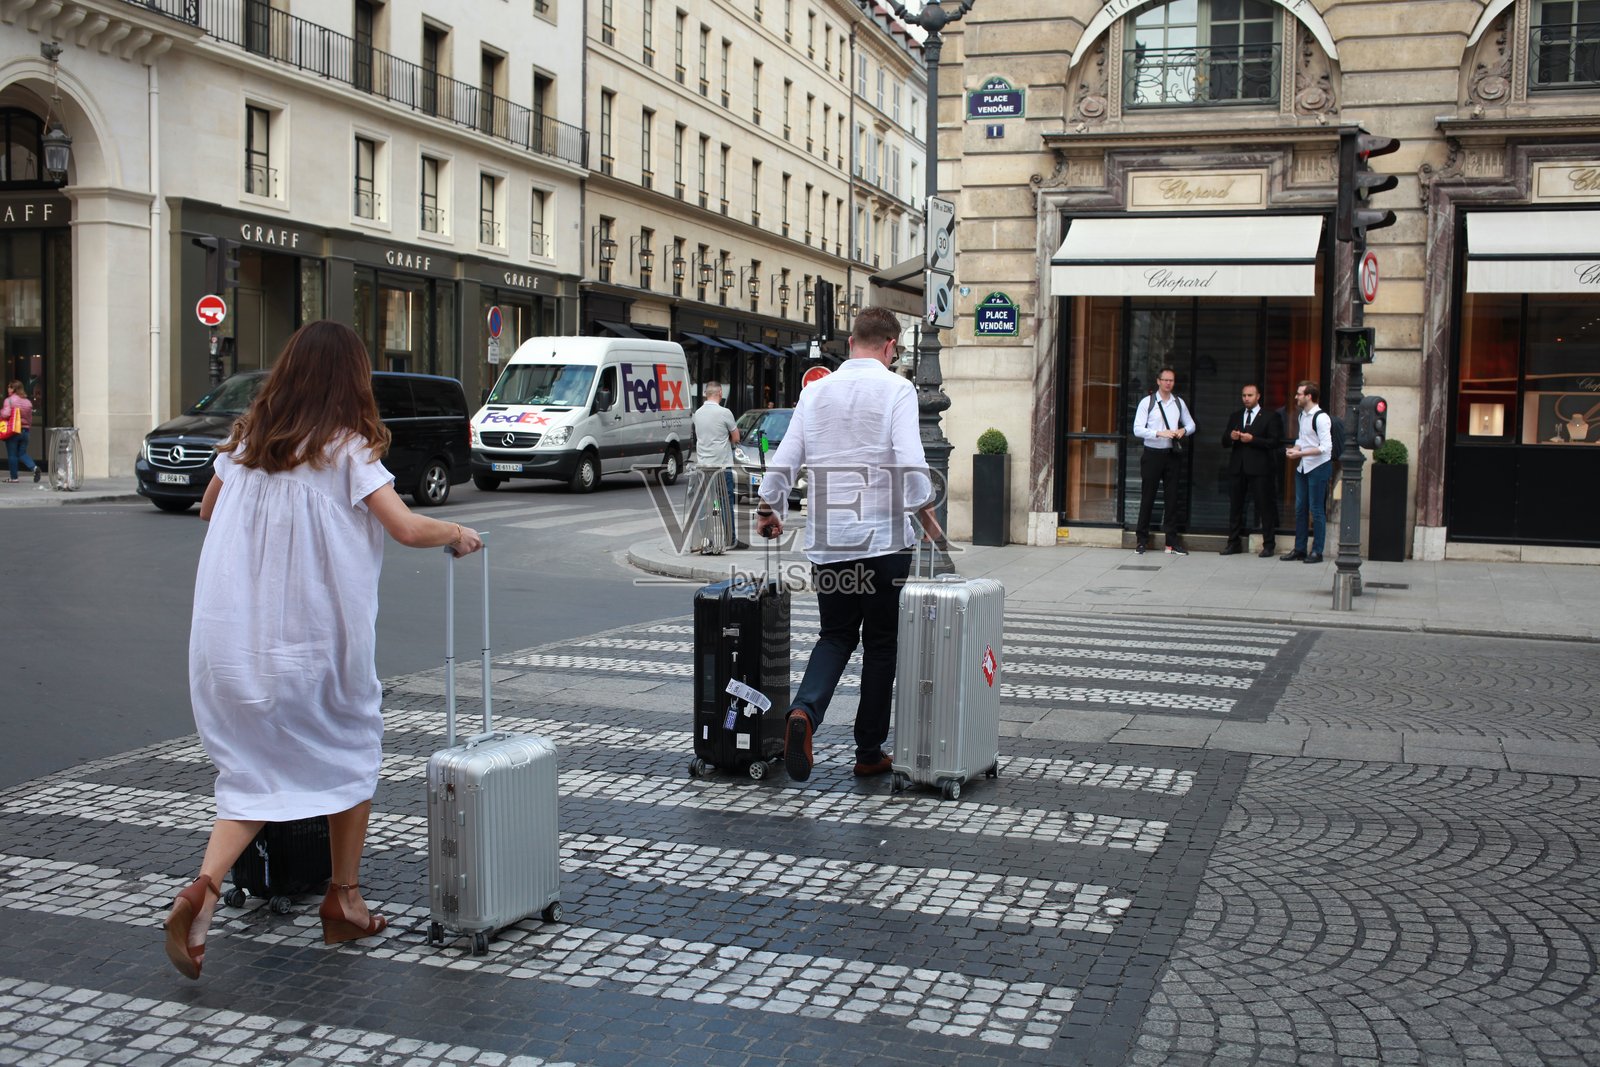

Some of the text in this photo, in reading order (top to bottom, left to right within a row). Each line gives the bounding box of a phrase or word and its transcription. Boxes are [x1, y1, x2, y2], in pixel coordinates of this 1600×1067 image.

[983, 95, 1008, 103] PLACE
[977, 104, 1014, 113] VENDÔME
[1158, 178, 1235, 204] Chopard
[240, 223, 300, 248] GRAFF
[938, 236, 947, 250] 30
[386, 250, 431, 271] GRAFF
[504, 271, 539, 289] GRAFF
[1143, 268, 1218, 292] Chopard
[985, 310, 1008, 319] PLACE
[620, 363, 685, 413] FedEx
[480, 412, 552, 426] FedEx
